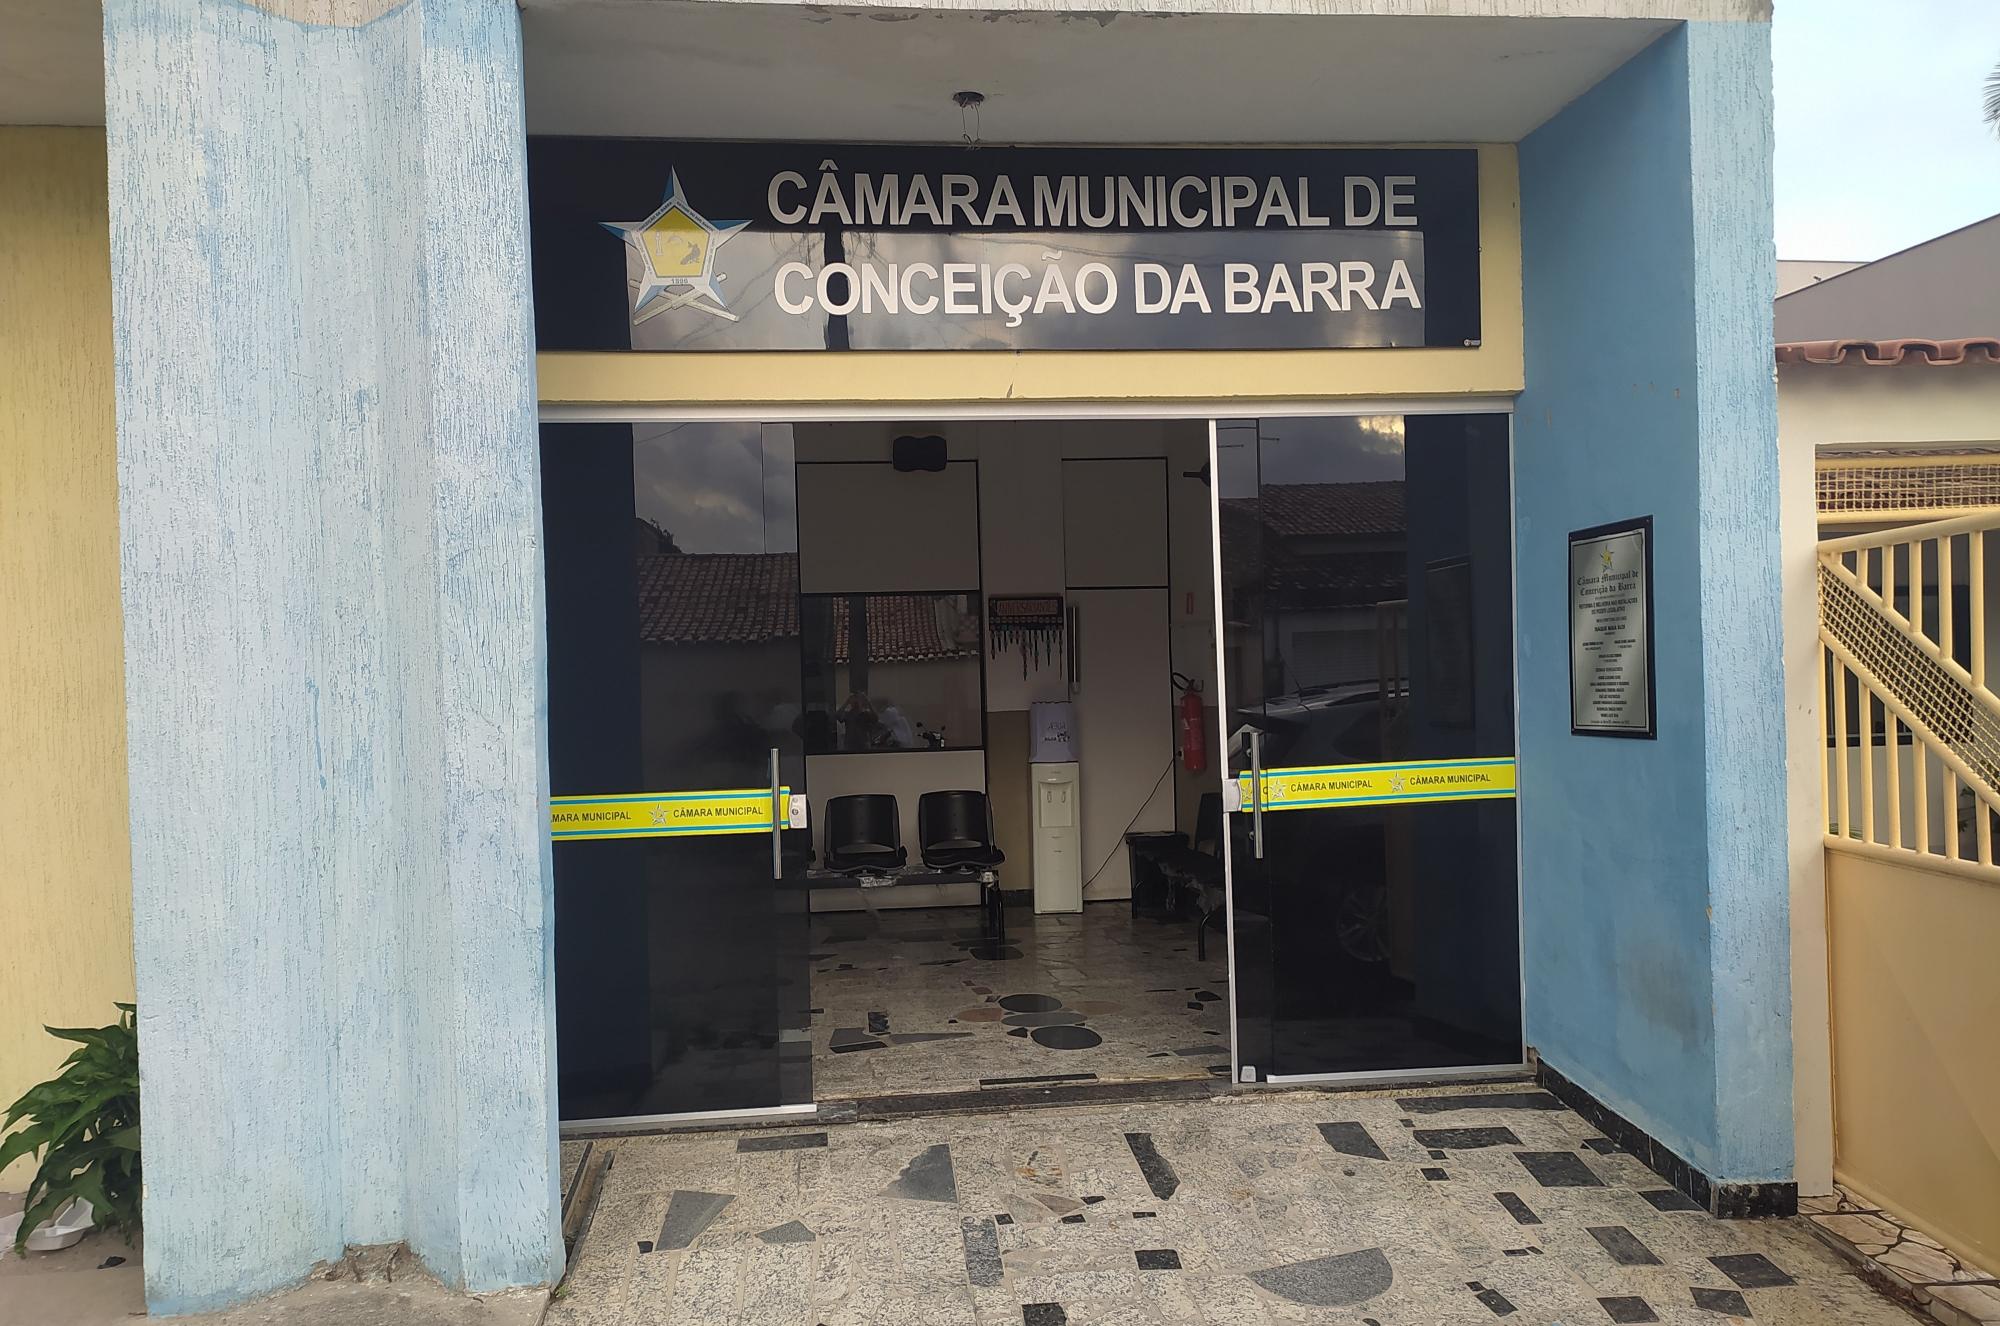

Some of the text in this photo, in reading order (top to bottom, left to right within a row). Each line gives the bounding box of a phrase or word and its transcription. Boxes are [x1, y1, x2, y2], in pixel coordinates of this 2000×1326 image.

[767, 159, 1026, 226] CÂMARA
[1033, 175, 1330, 228] MUNICIPAL
[1344, 175, 1418, 227] DE
[774, 250, 1118, 328] CONCEIÇÃO
[1134, 263, 1212, 314] DA
[1224, 259, 1422, 314] BARRA
[1290, 779, 1373, 793] CÂMARA MUNICIPAL
[1409, 773, 1492, 786] CÂMARA MUNICIPAL
[550, 811, 632, 823] MARA MUNICIPAL
[673, 806, 764, 818] CÂMARA MUNICIPAL
